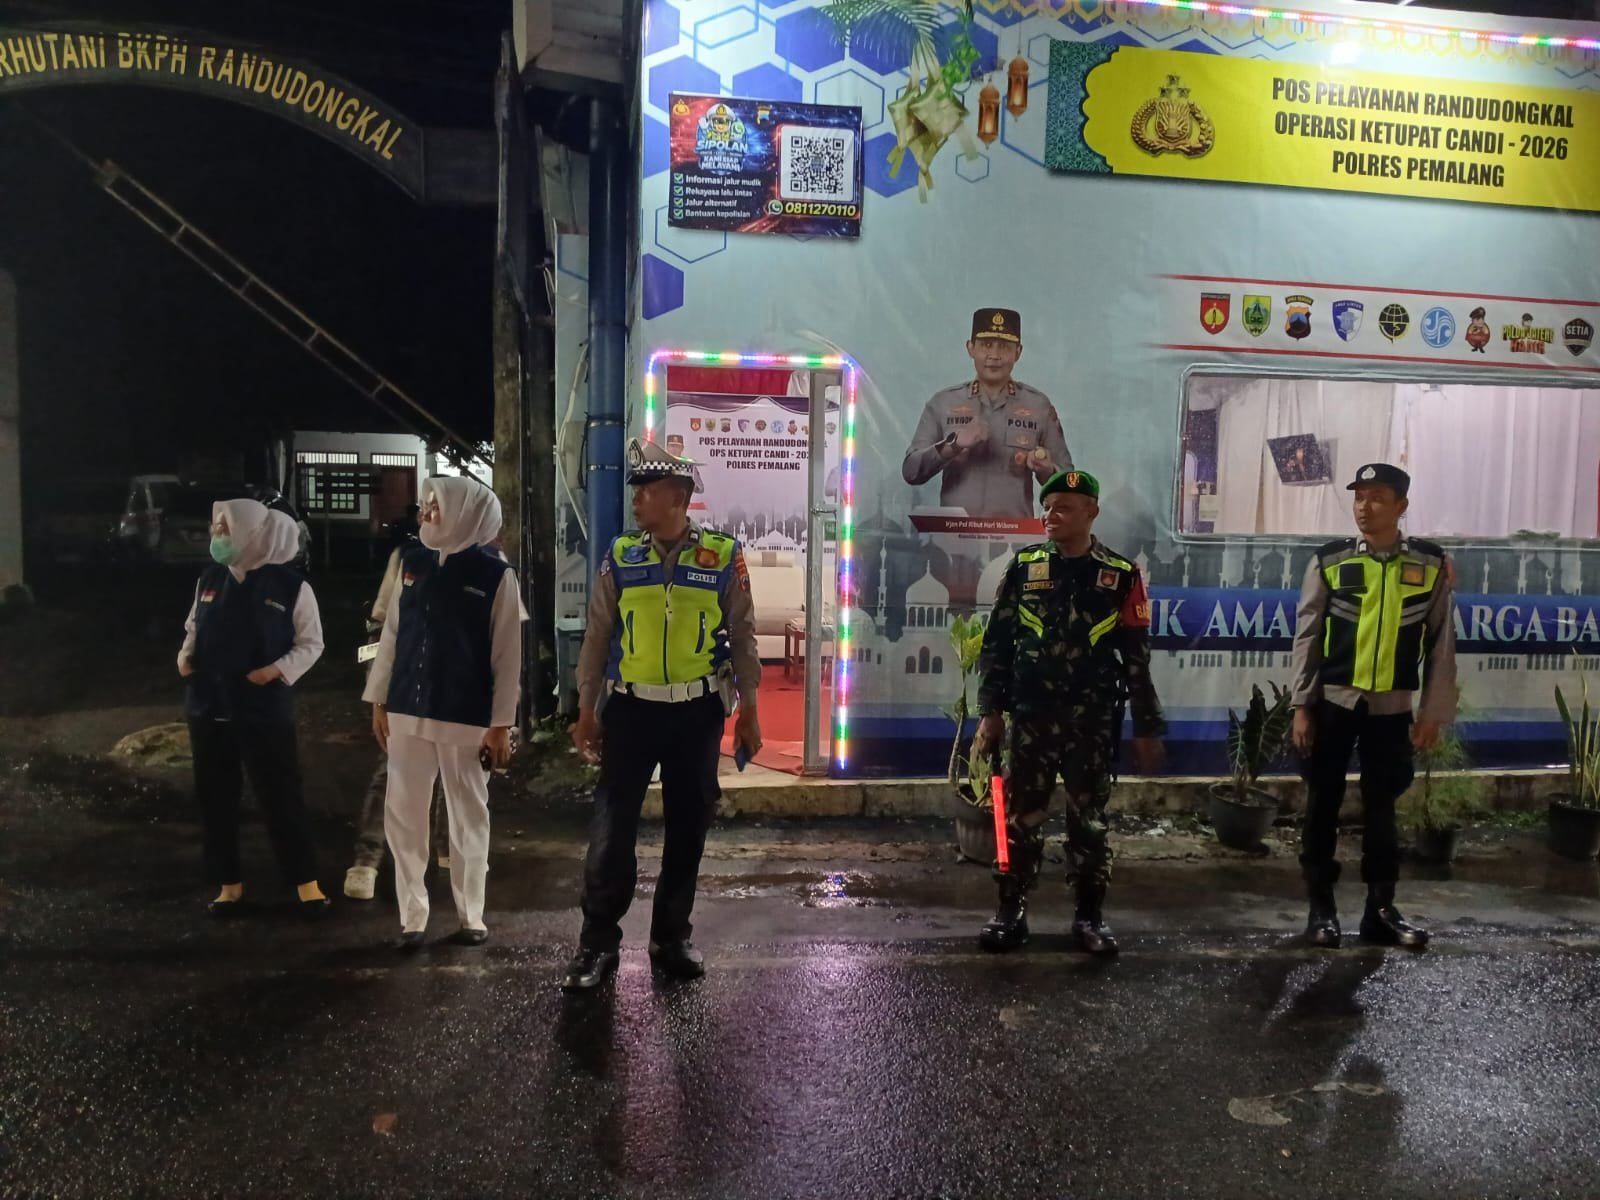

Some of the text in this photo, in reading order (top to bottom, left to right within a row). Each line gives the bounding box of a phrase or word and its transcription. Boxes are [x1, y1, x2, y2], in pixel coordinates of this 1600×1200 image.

[117, 32, 188, 75] BKPH
[198, 46, 402, 160] RANDUDONGKAL
[1272, 77, 1574, 128] POS PELAYANAN RANDUDONGKAL
[1275, 111, 1356, 141] OPERASI
[1361, 120, 1441, 149] KETUPAT
[1446, 128, 1504, 154] CANDI
[1519, 134, 1568, 160] 2026
[696, 140, 748, 153] SIPOLAN
[1332, 151, 1504, 187] POLRES PEMALANG
[686, 175, 722, 184] Informasi
[724, 177, 740, 186] jalur
[686, 187, 720, 197] Rekayasa
[735, 189, 753, 197] lintas
[704, 199, 737, 207] alternatif
[717, 210, 750, 218] kepolisian
[785, 202, 856, 216] 0811270110
[1566, 325, 1589, 336] SETIA
[1007, 418, 1037, 430] POLRI
[699, 437, 716, 446] POS
[717, 438, 760, 447] PELAYANAN
[710, 449, 726, 458] OPS
[728, 449, 762, 458] KETUPAT
[764, 450, 790, 459] CANDI
[727, 461, 800, 471] POLRES PEMALANG
[687, 572, 717, 583] POLISI
[1203, 599, 1297, 638] AMA
